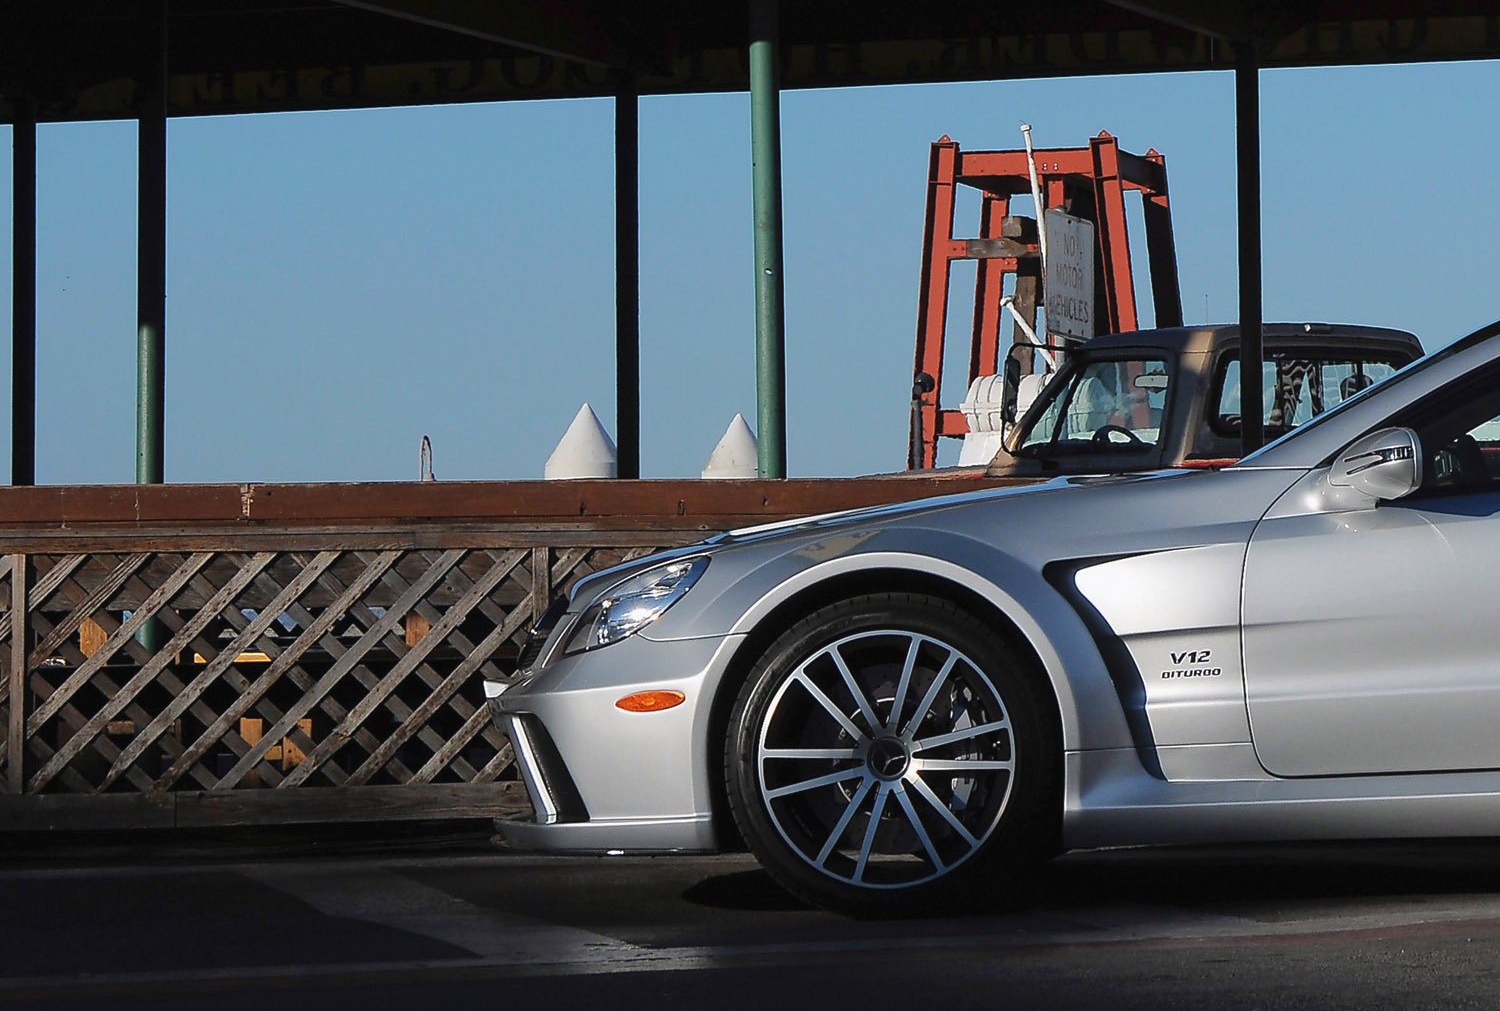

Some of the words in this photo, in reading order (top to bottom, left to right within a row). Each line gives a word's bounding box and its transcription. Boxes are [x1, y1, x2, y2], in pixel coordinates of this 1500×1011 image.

[1063, 233, 1075, 256] NO
[1055, 262, 1083, 290] MOTOR
[1170, 650, 1211, 665] V12
